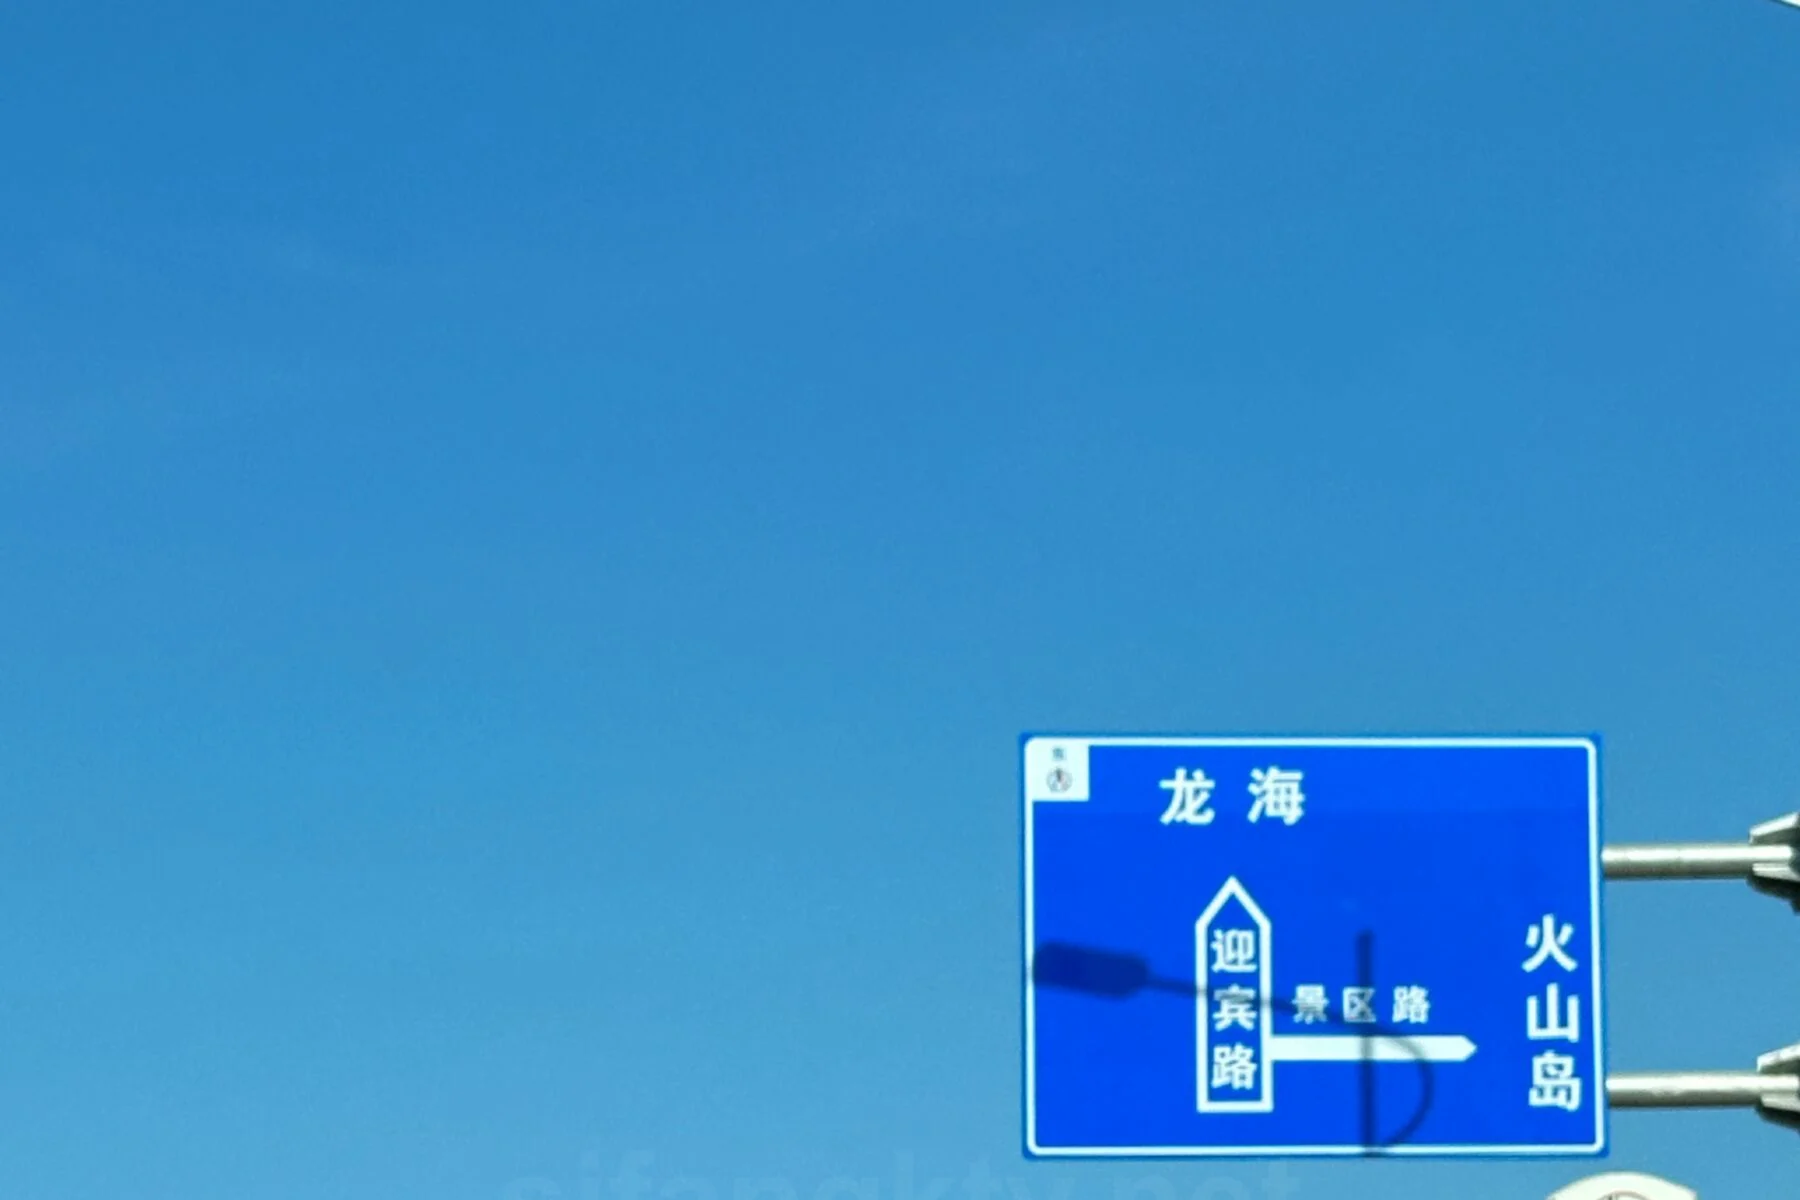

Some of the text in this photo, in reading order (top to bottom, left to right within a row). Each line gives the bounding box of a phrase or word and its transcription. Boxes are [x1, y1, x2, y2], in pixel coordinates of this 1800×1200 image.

[1160, 766, 1305, 825] 龙海
[1211, 929, 1258, 1090] 迎宾路
[1293, 984, 1430, 1024] 景区路
[1522, 914, 1582, 1111] 火山岛
